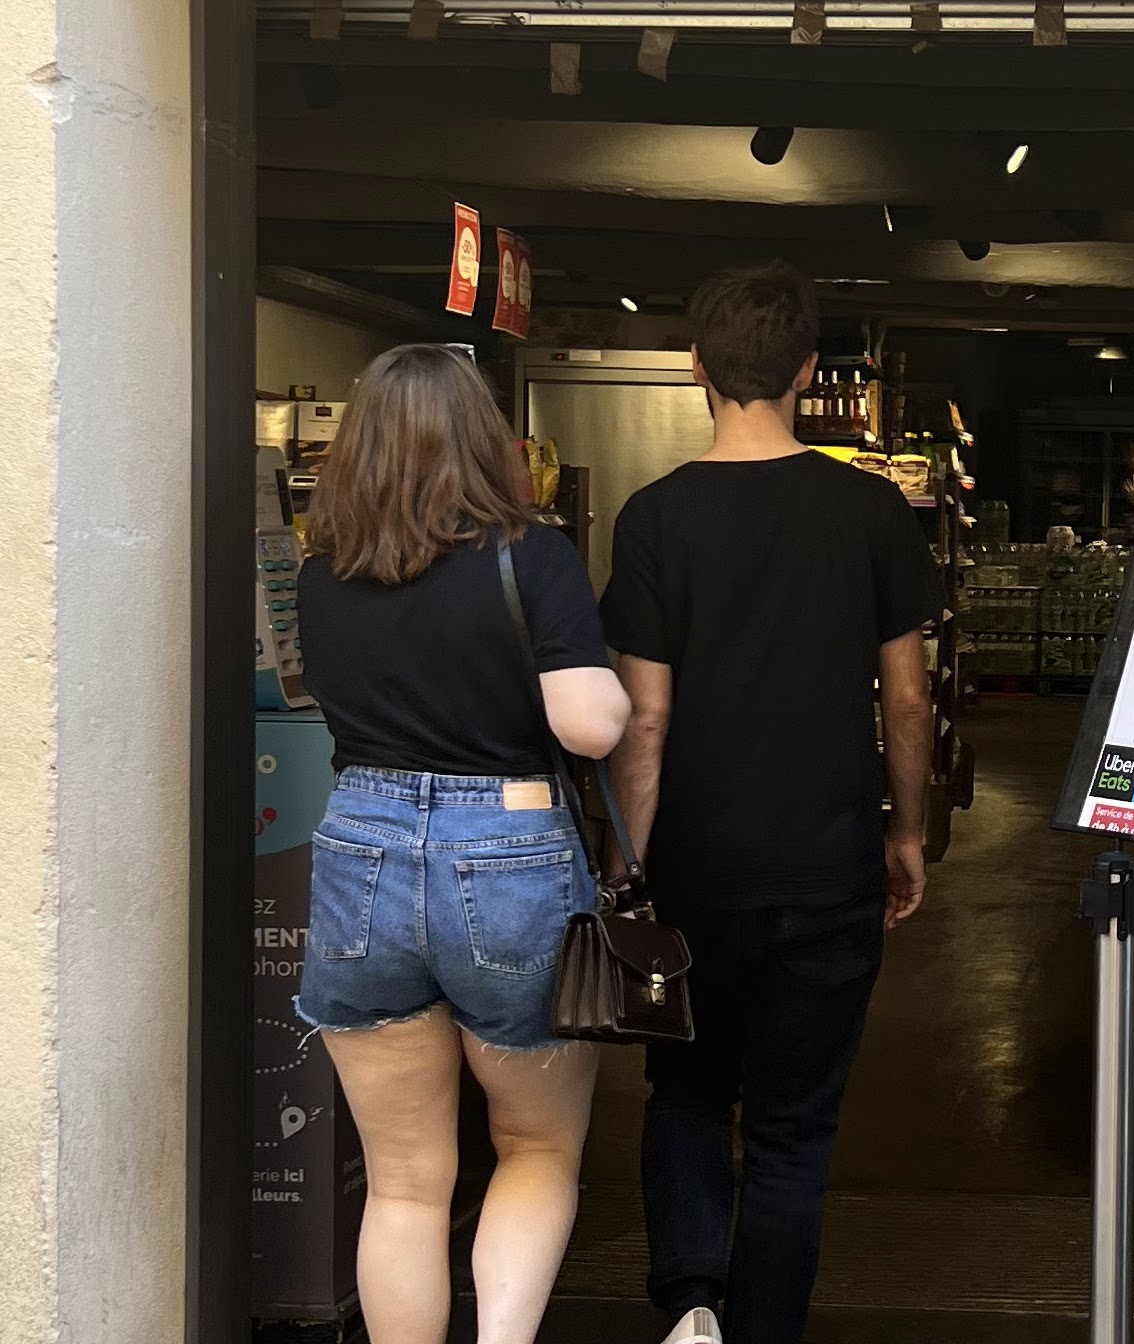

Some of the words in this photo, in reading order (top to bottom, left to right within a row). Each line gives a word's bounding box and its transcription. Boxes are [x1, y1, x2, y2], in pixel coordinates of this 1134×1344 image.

[1098, 771, 1131, 792] Eats
[1095, 805, 1122, 819] Service
[1123, 810, 1134, 819] de
[284, 1168, 304, 1182] Ici
